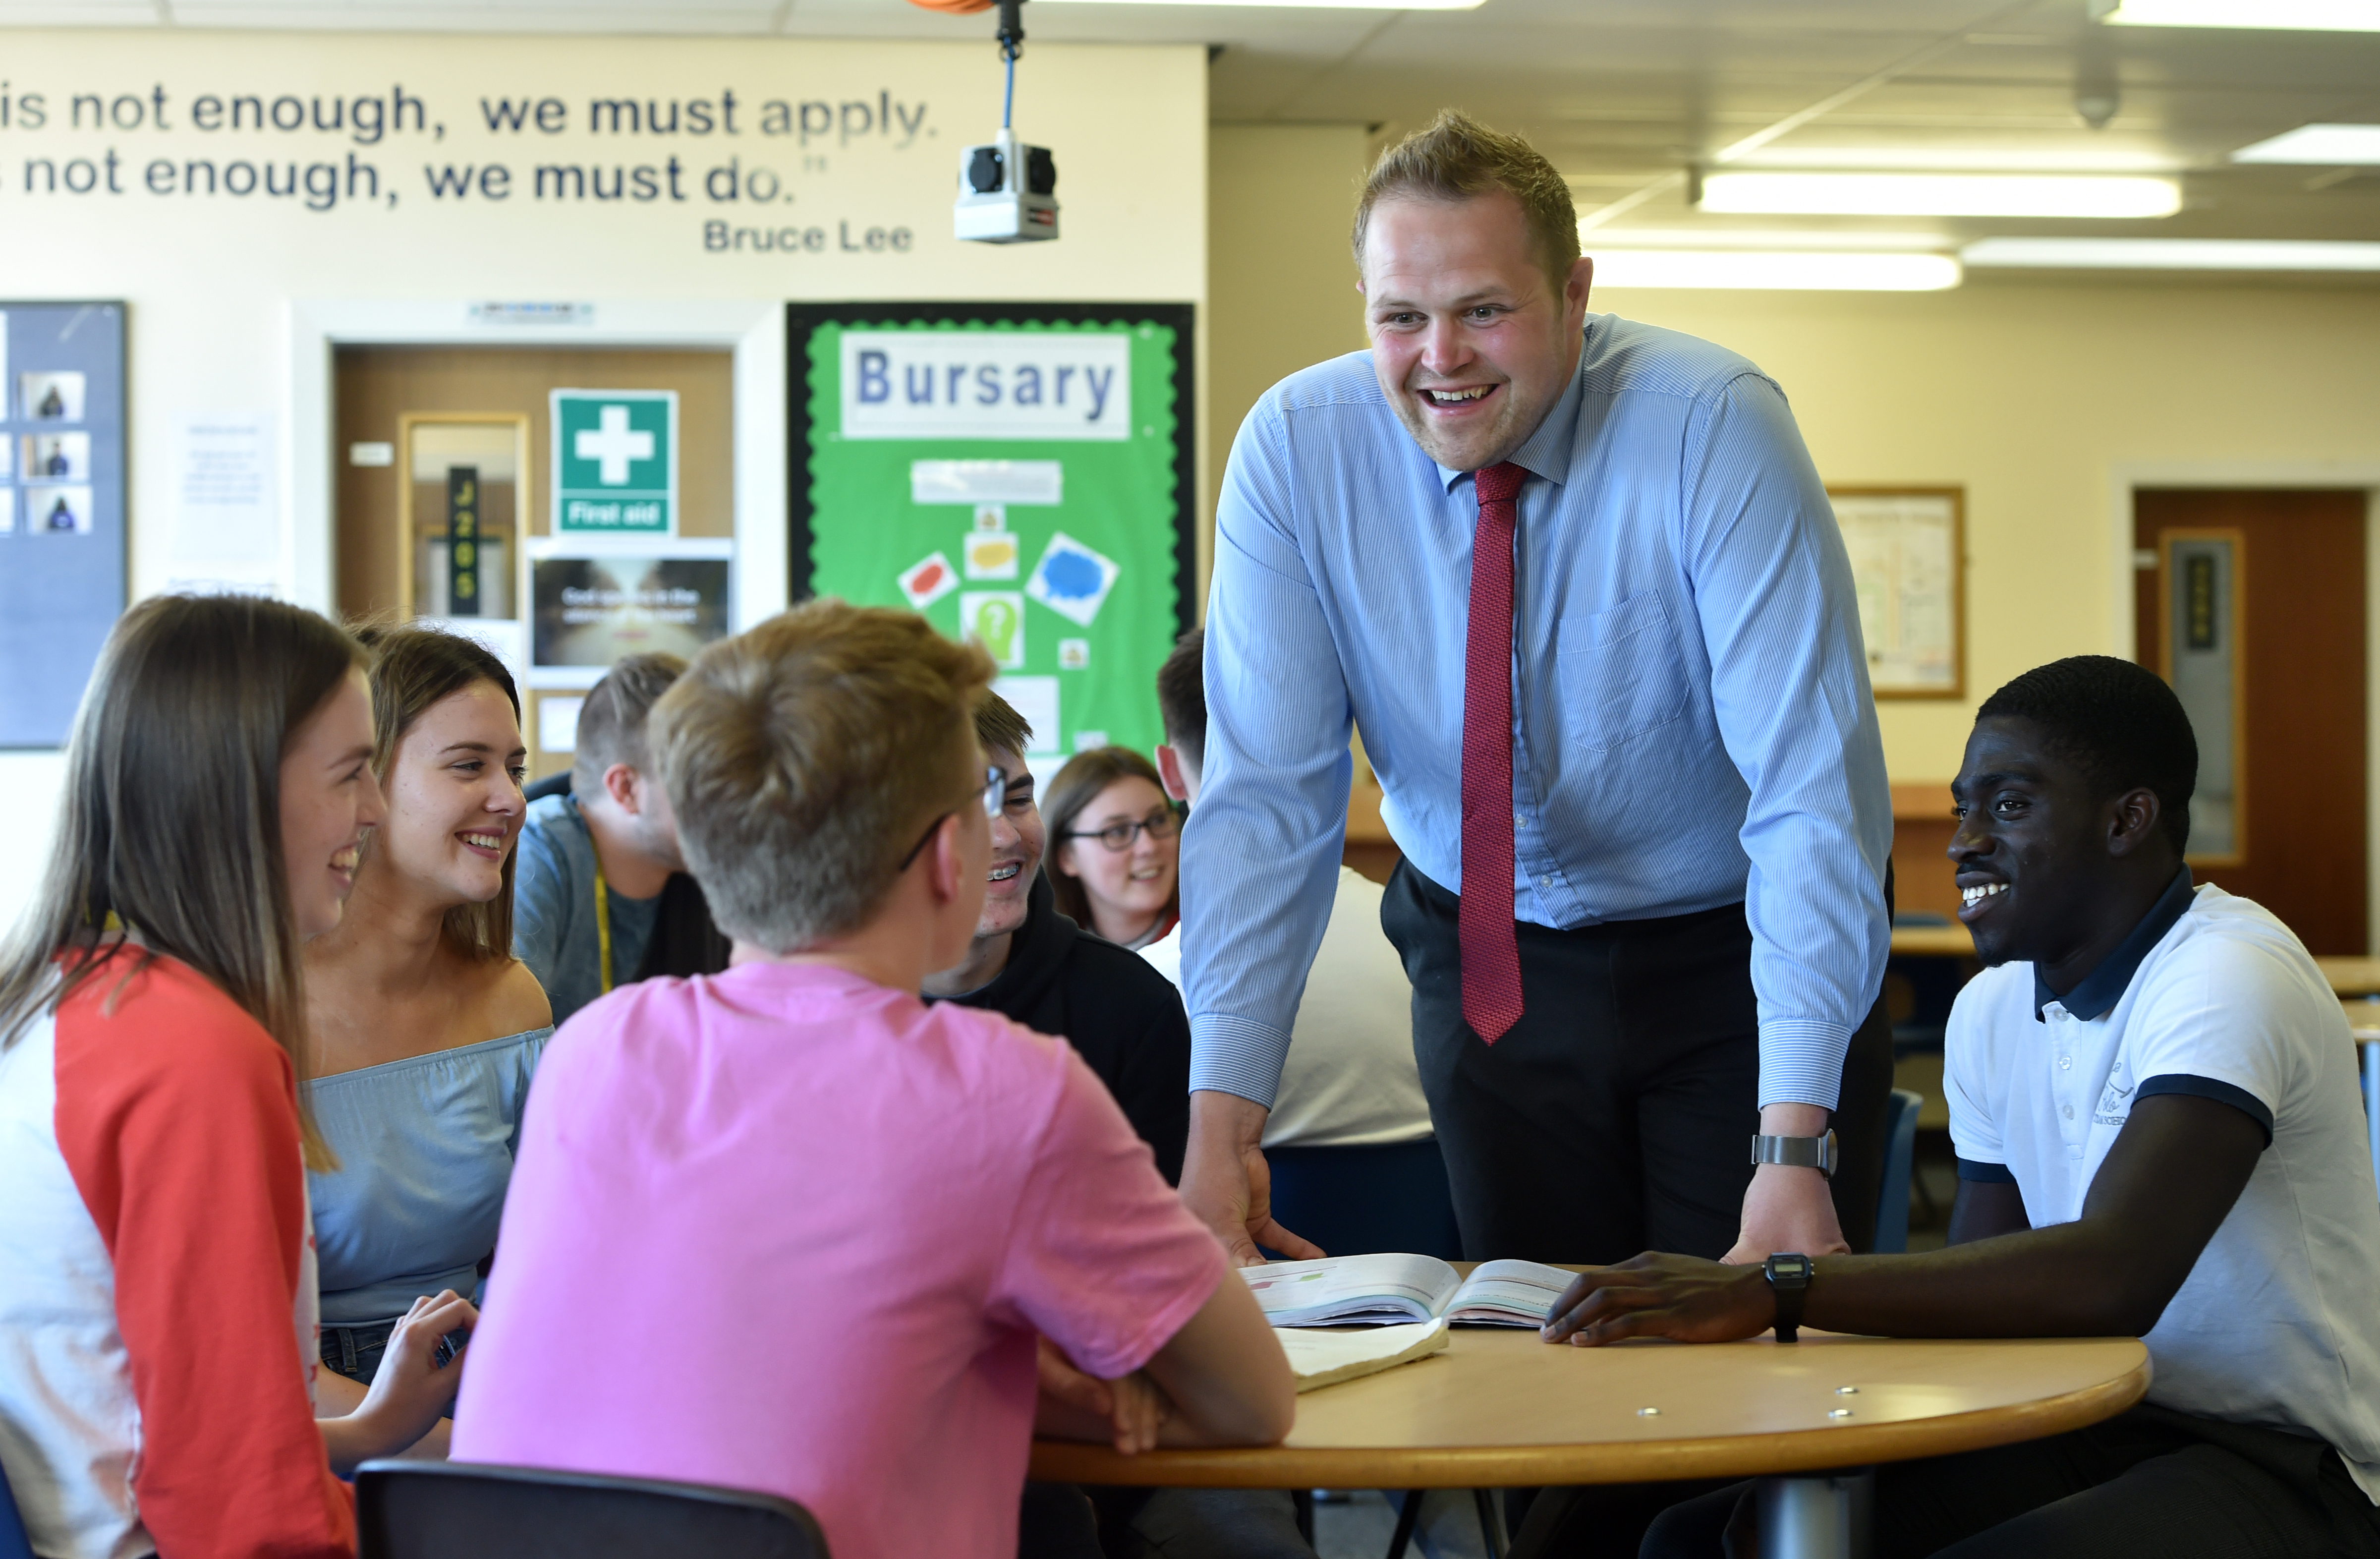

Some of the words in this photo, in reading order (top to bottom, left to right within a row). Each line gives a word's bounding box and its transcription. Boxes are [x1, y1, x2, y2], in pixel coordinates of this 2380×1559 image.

[0, 80, 47, 130] is
[71, 83, 172, 130] not
[192, 84, 446, 145] enough,
[480, 95, 569, 137] we
[589, 89, 739, 137] must
[760, 90, 938, 150] apply.
[24, 148, 124, 196] not
[145, 151, 398, 212] enough,
[425, 163, 511, 200] we
[535, 156, 688, 200] must
[704, 220, 826, 252] Bruce
[839, 220, 913, 252] Lee
[856, 349, 1114, 424] Bursary
[568, 502, 618, 525] First
[623, 501, 660, 525] aid
